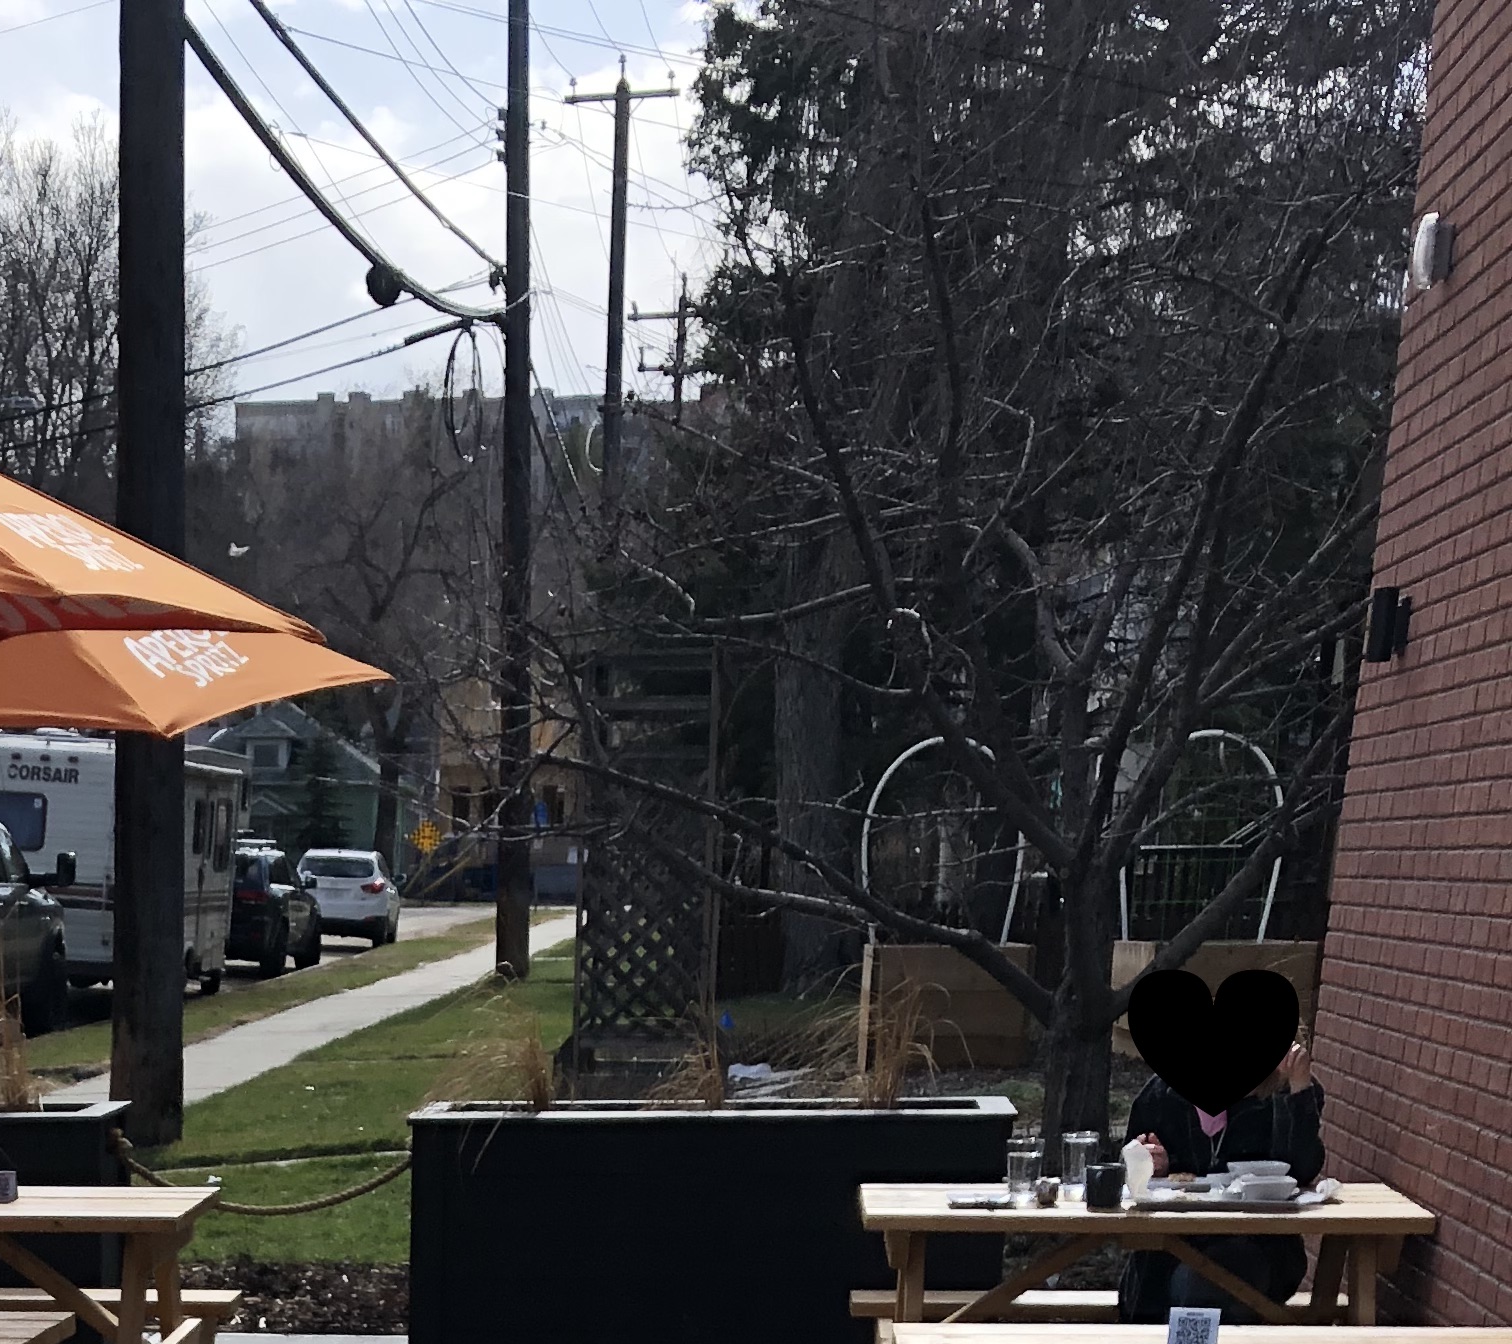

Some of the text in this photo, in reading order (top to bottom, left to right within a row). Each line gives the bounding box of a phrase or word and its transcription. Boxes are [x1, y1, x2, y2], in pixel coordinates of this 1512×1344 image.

[51, 543, 145, 572] SPRITZ
[123, 629, 230, 678] APER
[175, 640, 250, 687] SPRITZ
[8, 763, 80, 784] CORSAIR
